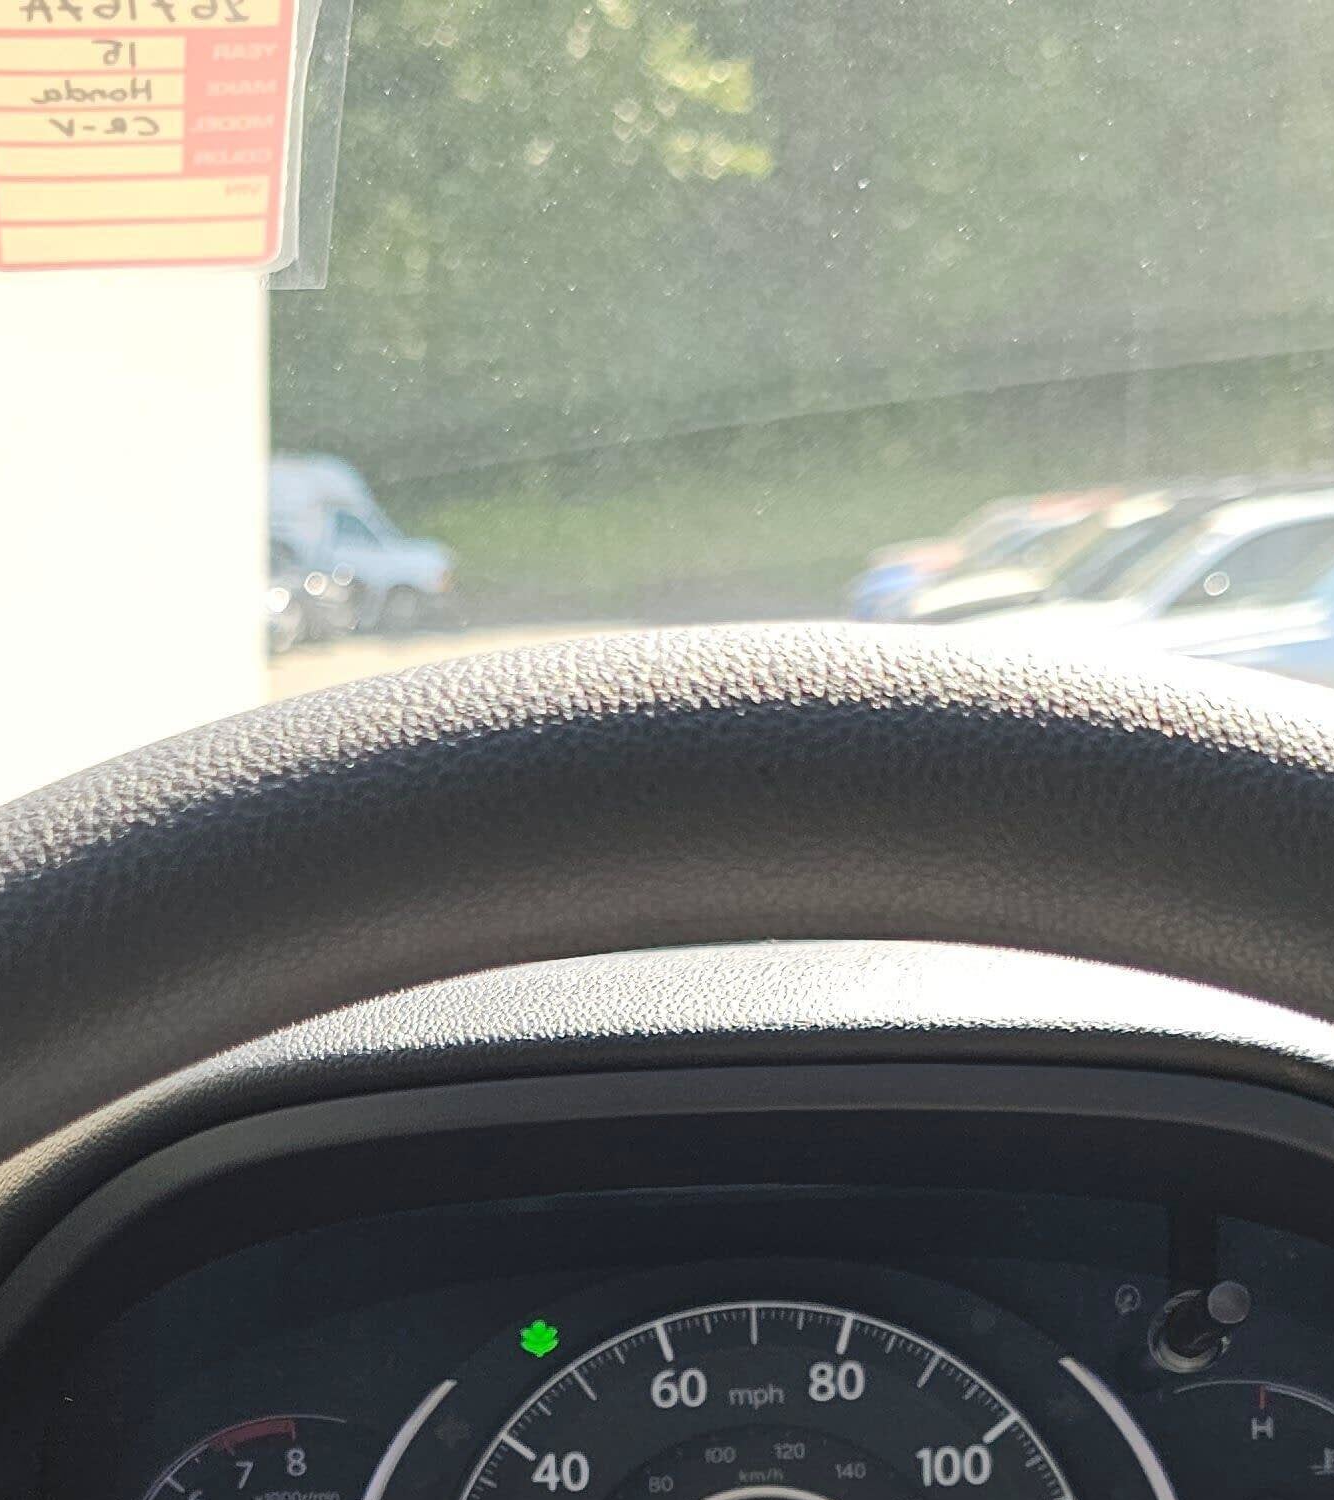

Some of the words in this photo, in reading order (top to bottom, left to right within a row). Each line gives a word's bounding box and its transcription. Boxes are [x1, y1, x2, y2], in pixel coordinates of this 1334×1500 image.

[651, 1369, 709, 1410] 60
[728, 1380, 785, 1411] mph
[808, 1360, 866, 1403] 80
[285, 1447, 308, 1477] 8
[704, 1446, 737, 1464] 100
[773, 1442, 806, 1462] 120
[235, 1461, 255, 1490] 7
[531, 1451, 590, 1493] 40
[738, 1467, 785, 1484] km/h
[835, 1463, 867, 1480] 140
[917, 1444, 992, 1488] 100
[649, 1475, 675, 1493] 80
